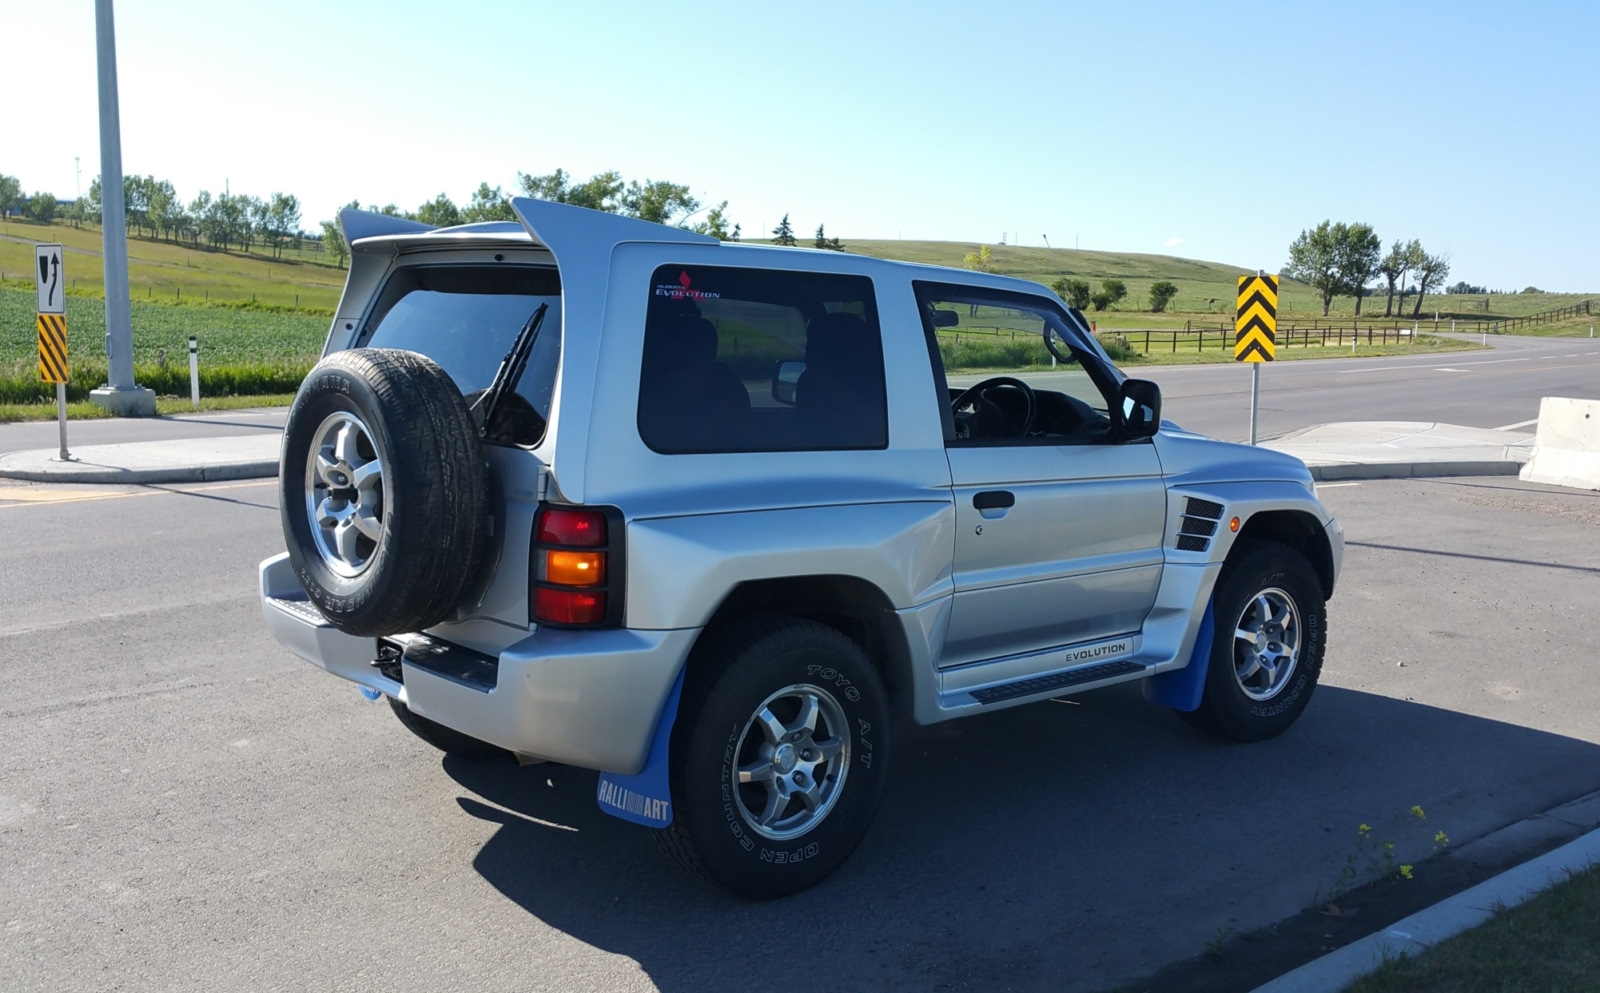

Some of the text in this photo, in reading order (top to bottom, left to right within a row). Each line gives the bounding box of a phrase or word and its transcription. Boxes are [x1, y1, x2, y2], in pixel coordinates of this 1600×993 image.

[655, 288, 720, 299] EVOLUTION
[1065, 643, 1126, 662] EVOLUTION
[1250, 614, 1317, 717] OPEN COUNTRY
[807, 664, 873, 769] TOYO A/T
[721, 723, 819, 864] OPEN COUNTRY
